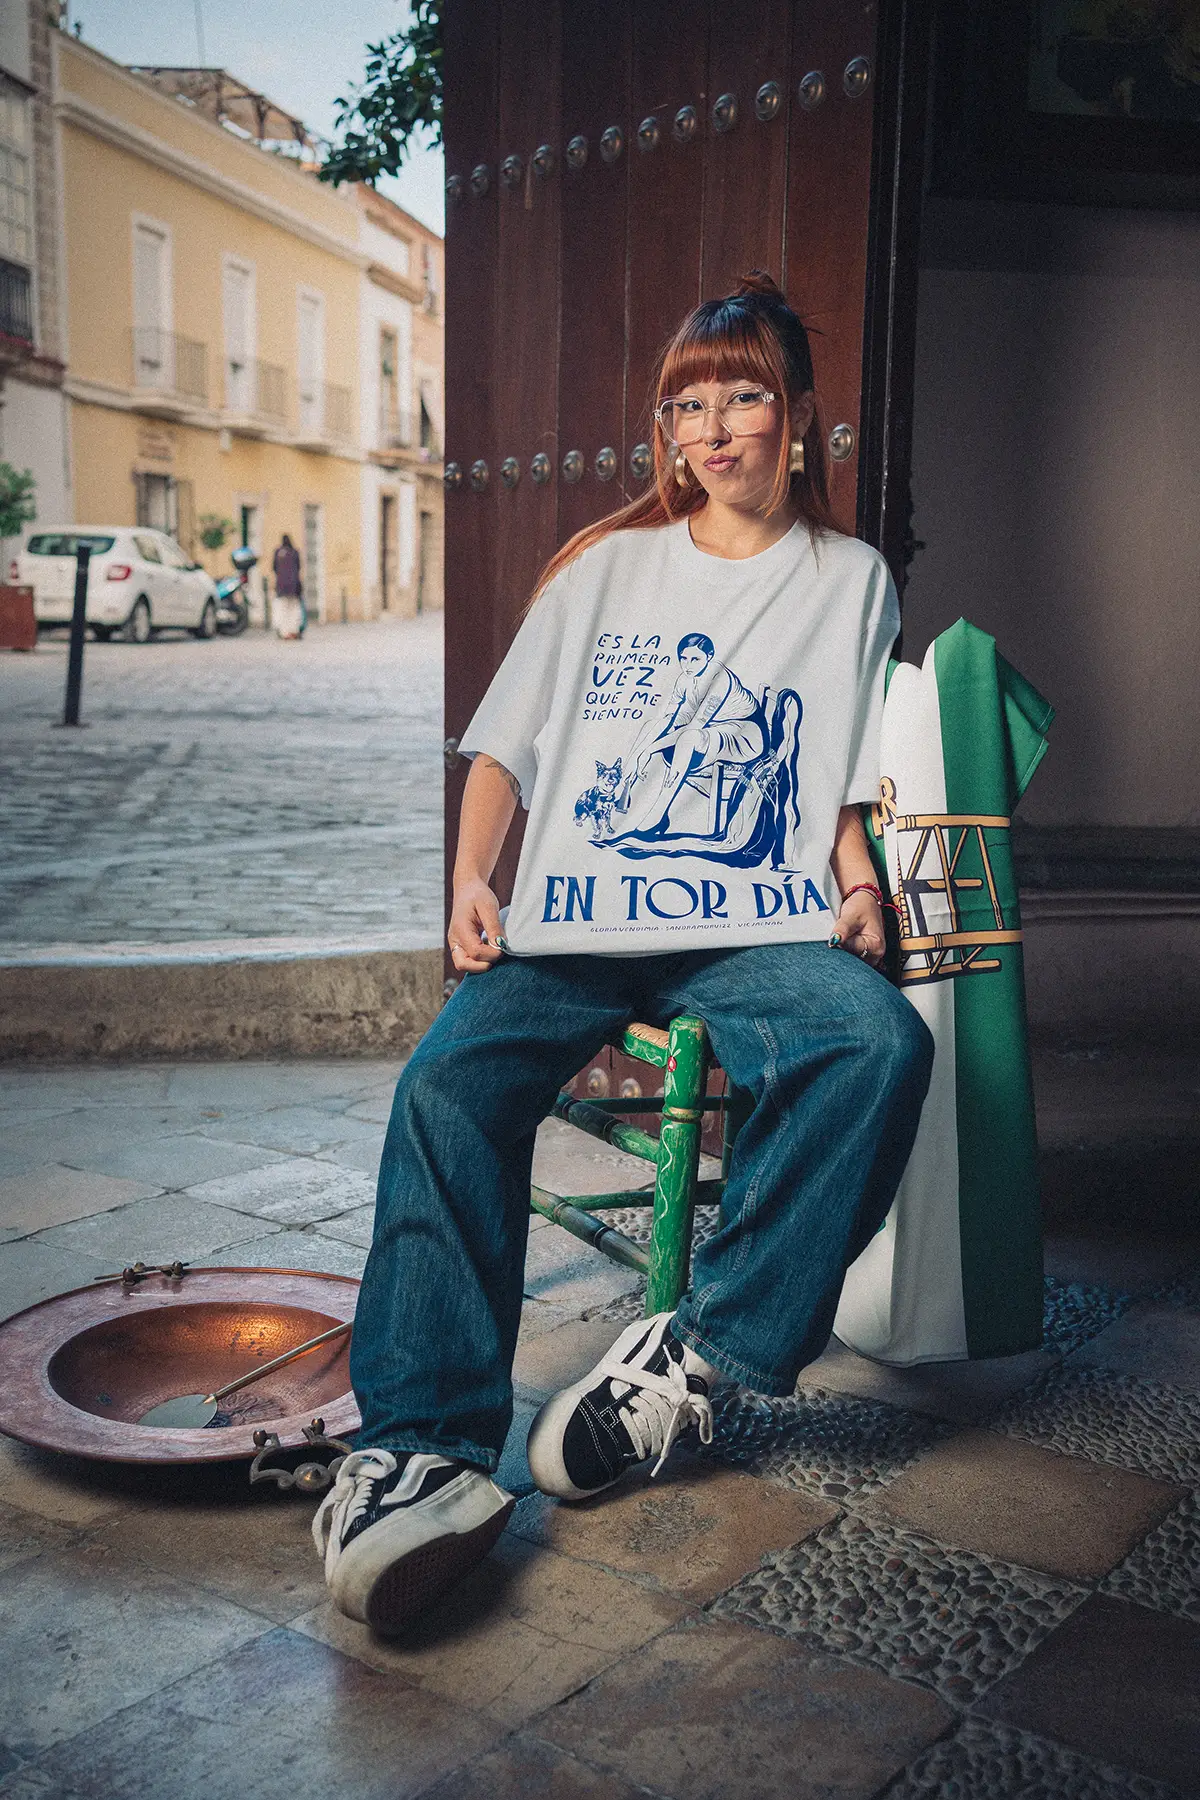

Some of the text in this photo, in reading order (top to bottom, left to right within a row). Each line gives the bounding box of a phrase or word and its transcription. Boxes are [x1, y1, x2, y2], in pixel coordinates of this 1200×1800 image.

[597, 633, 661, 650] ES LA
[594, 652, 671, 666] PRIMERA
[592, 665, 656, 688] VEZ
[585, 691, 662, 707] QUE ME
[582, 707, 644, 722] SIENTO
[541, 873, 831, 923] EN TOR DÍA
